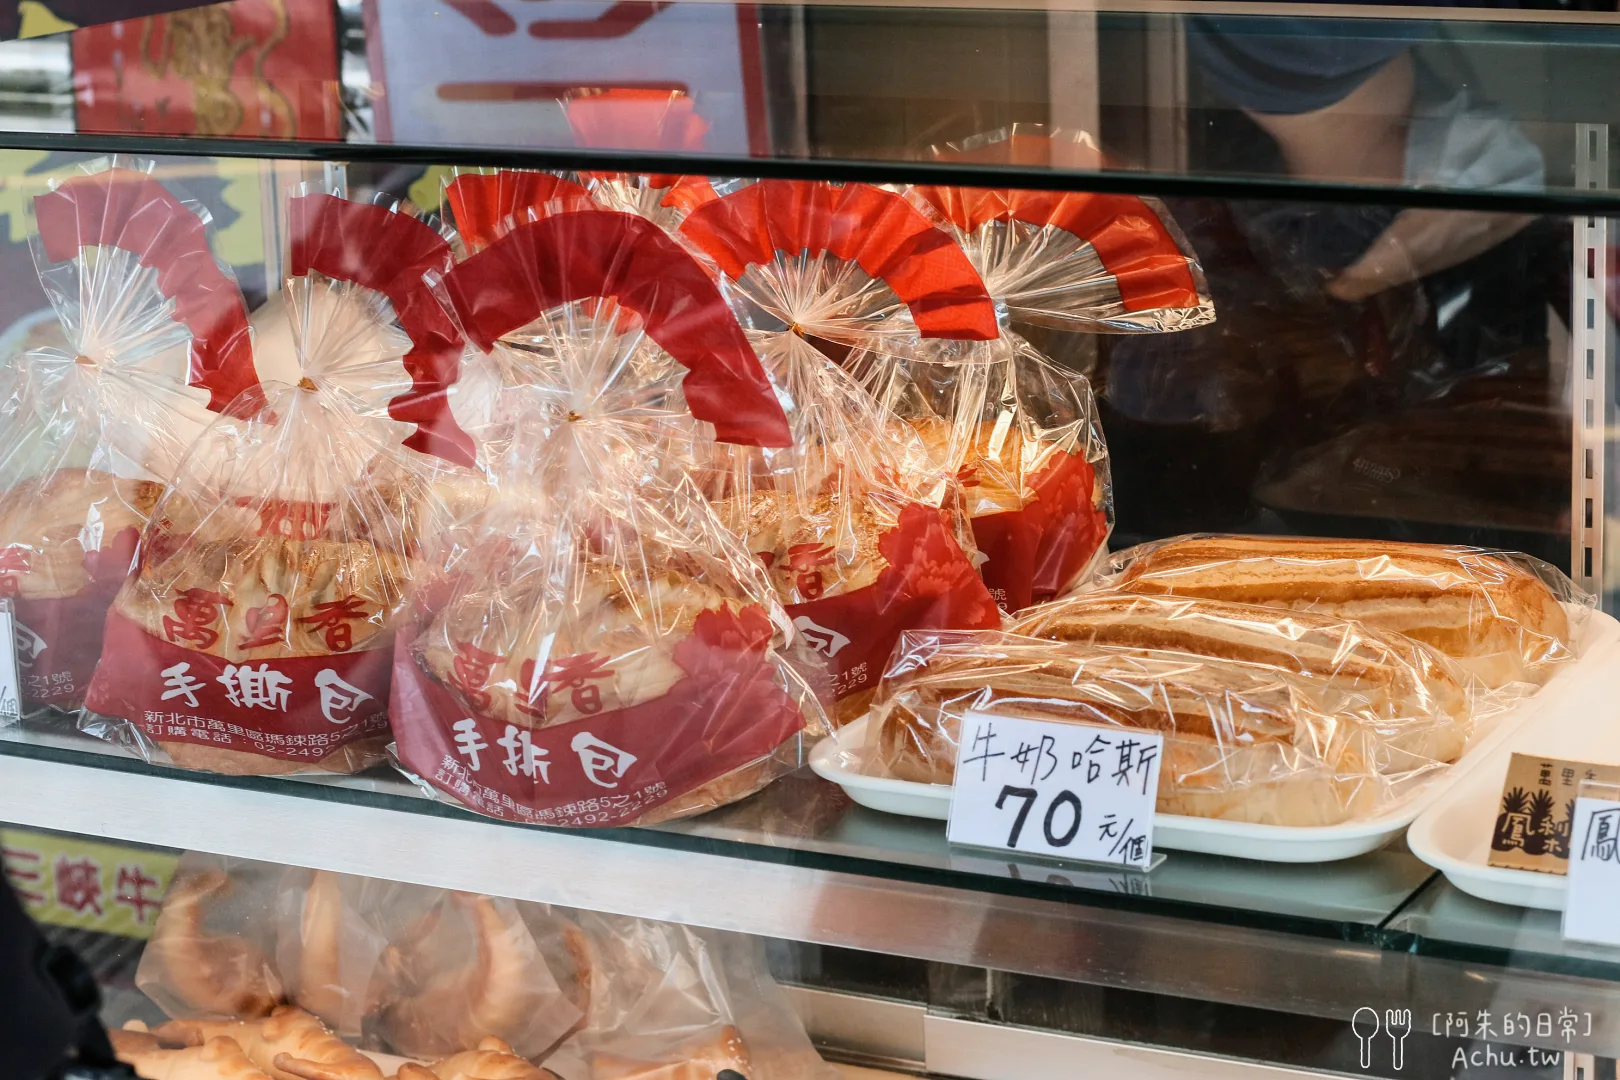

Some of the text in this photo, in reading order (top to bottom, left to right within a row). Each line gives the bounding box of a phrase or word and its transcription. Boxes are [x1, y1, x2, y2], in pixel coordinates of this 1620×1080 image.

[161, 661, 374, 724] 手撕包
[962, 722, 1158, 796] 牛奶哈斯
[994, 784, 1083, 849] 70
